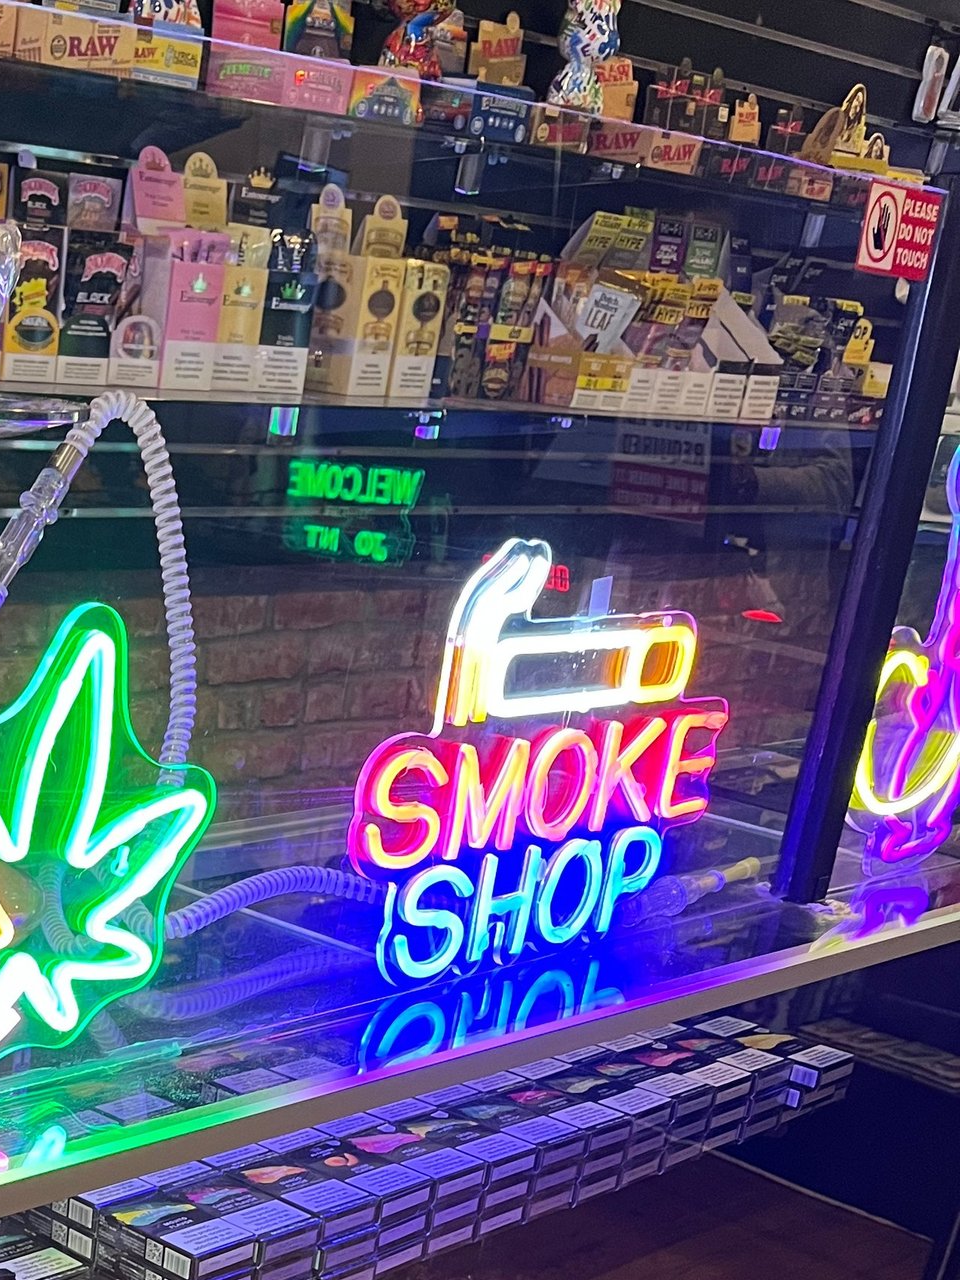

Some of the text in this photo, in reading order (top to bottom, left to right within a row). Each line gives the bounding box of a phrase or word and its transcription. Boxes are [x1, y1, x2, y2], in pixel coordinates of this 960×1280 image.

[67, 35, 119, 58] RAW
[482, 38, 521, 58] RAW
[596, 131, 641, 151] RAW
[661, 144, 697, 162] RAW
[902, 198, 940, 223] PLEASE
[898, 222, 935, 246] DO NOT
[894, 247, 930, 271] TOUCH
[76, 291, 112, 305] BLACK
[363, 710, 729, 869] SMOKE
[391, 825, 662, 979] SHOP
